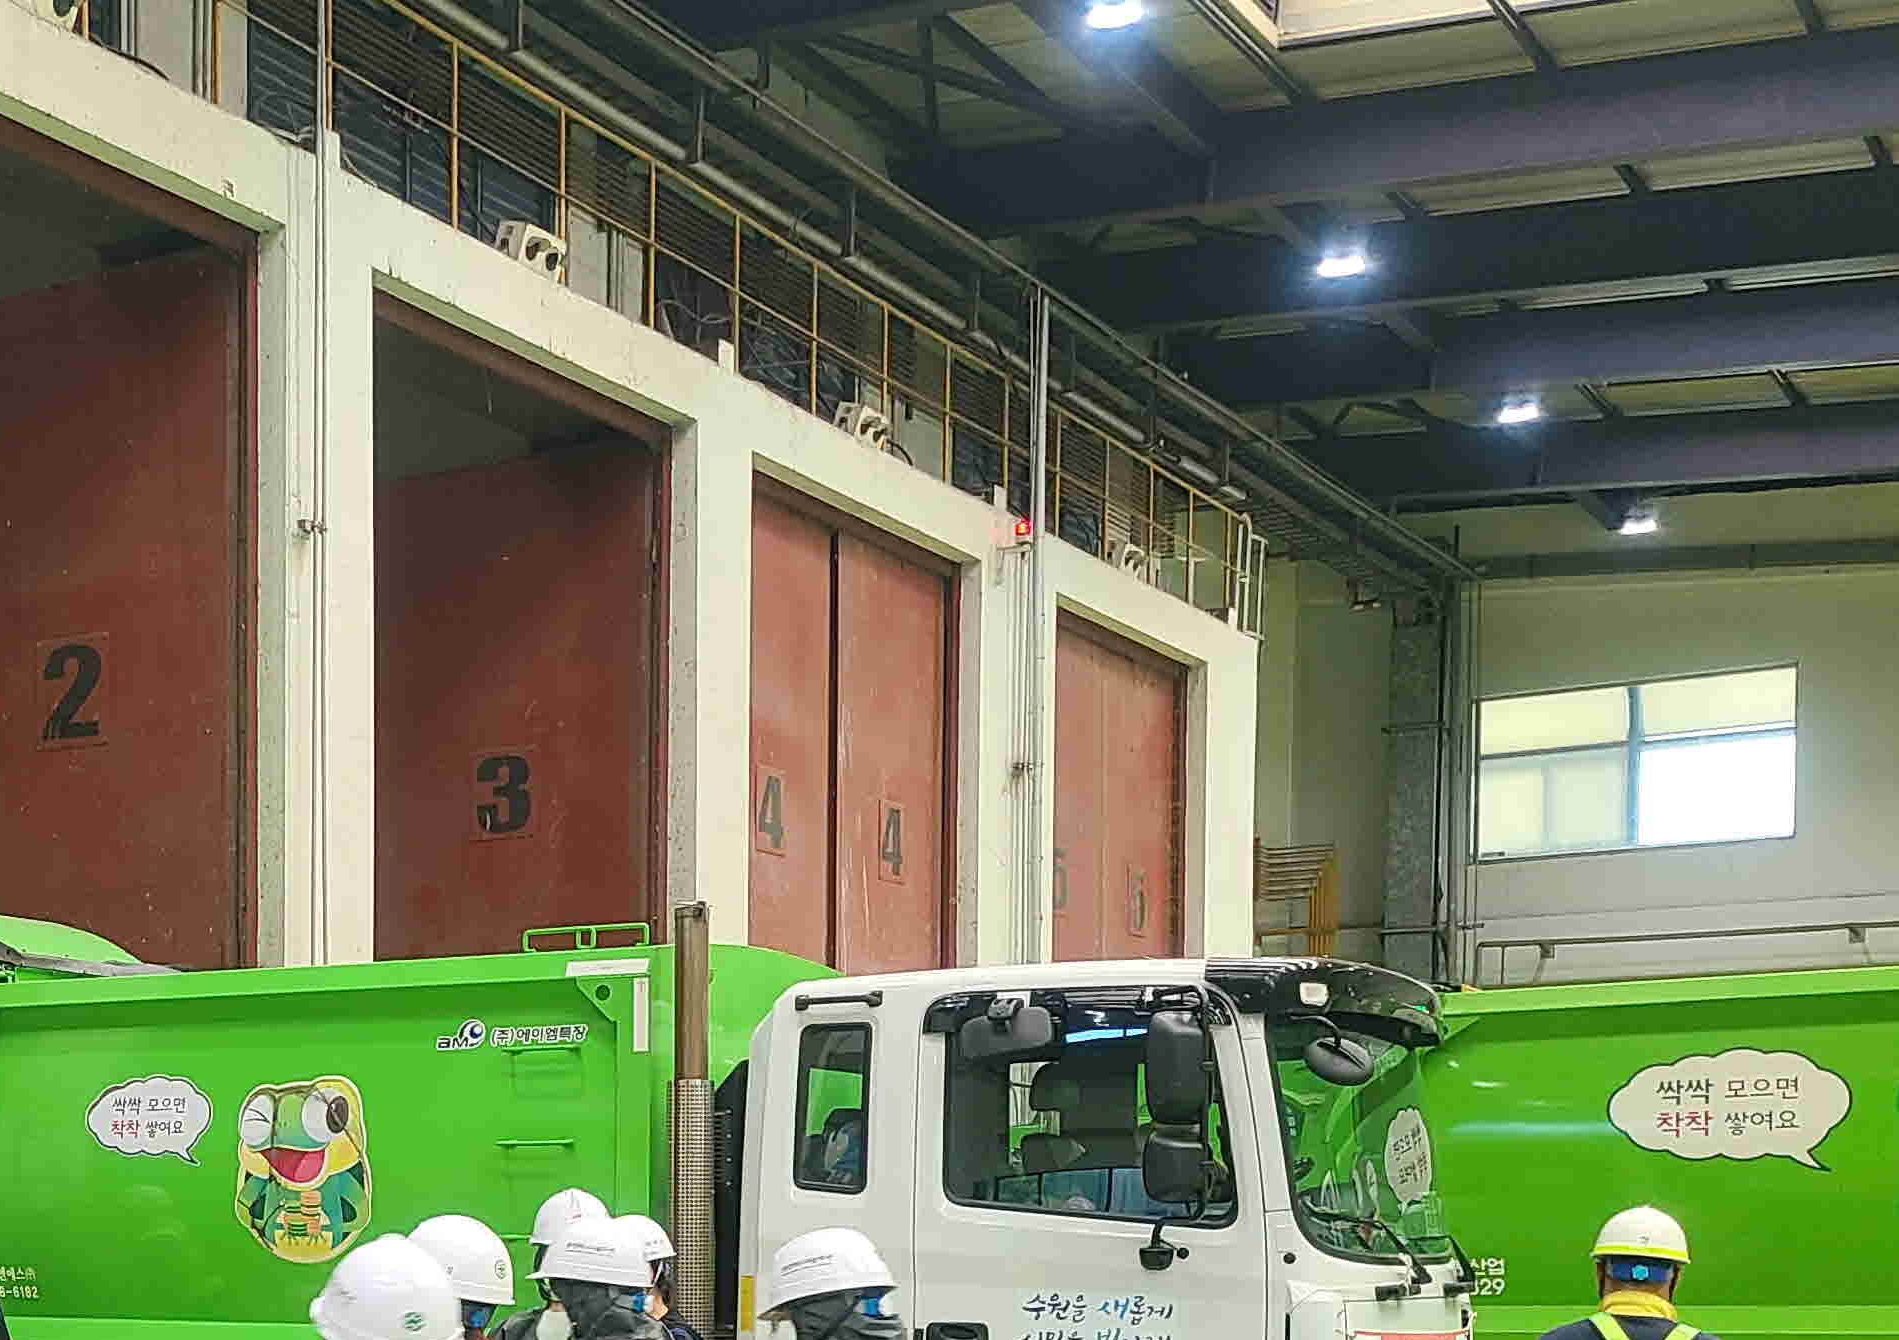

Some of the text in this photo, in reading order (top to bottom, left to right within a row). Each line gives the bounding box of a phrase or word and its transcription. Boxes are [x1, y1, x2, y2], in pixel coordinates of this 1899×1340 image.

[42, 643, 102, 742] 2
[475, 754, 533, 834] 3
[758, 775, 784, 849] 4
[882, 807, 903, 877] 4
[1724, 1075, 1800, 1101] 모으면
[145, 1096, 187, 1114] 모으면
[110, 1118, 185, 1138] 착착 쌓여요
[1656, 1109, 1801, 1138] 착착 쌓여요
[1021, 1294, 1087, 1323] 수원을
